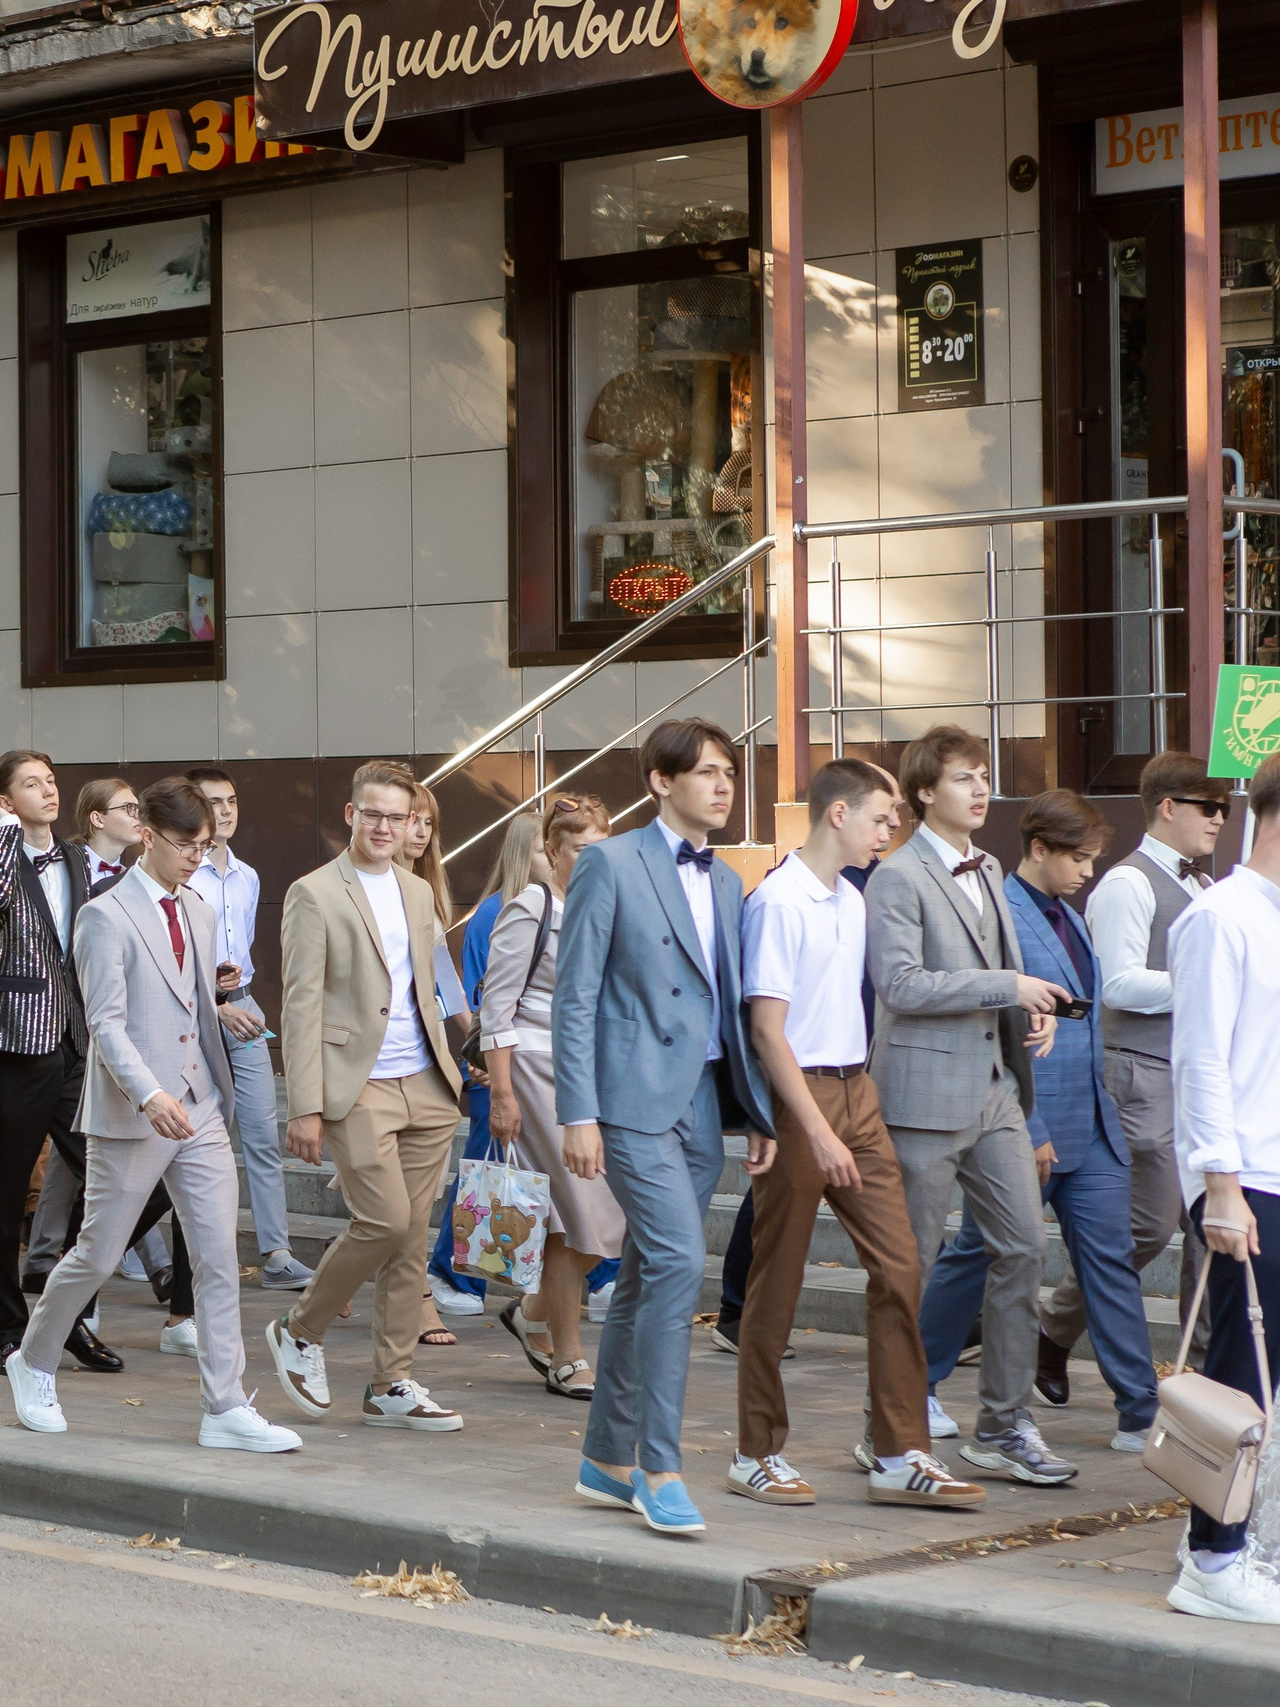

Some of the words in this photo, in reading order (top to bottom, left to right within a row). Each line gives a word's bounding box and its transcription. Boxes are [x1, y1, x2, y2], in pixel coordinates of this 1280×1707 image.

[82, 250, 130, 282] Sheba
[70, 303, 89, 317] Для
[130, 296, 159, 310] натур
